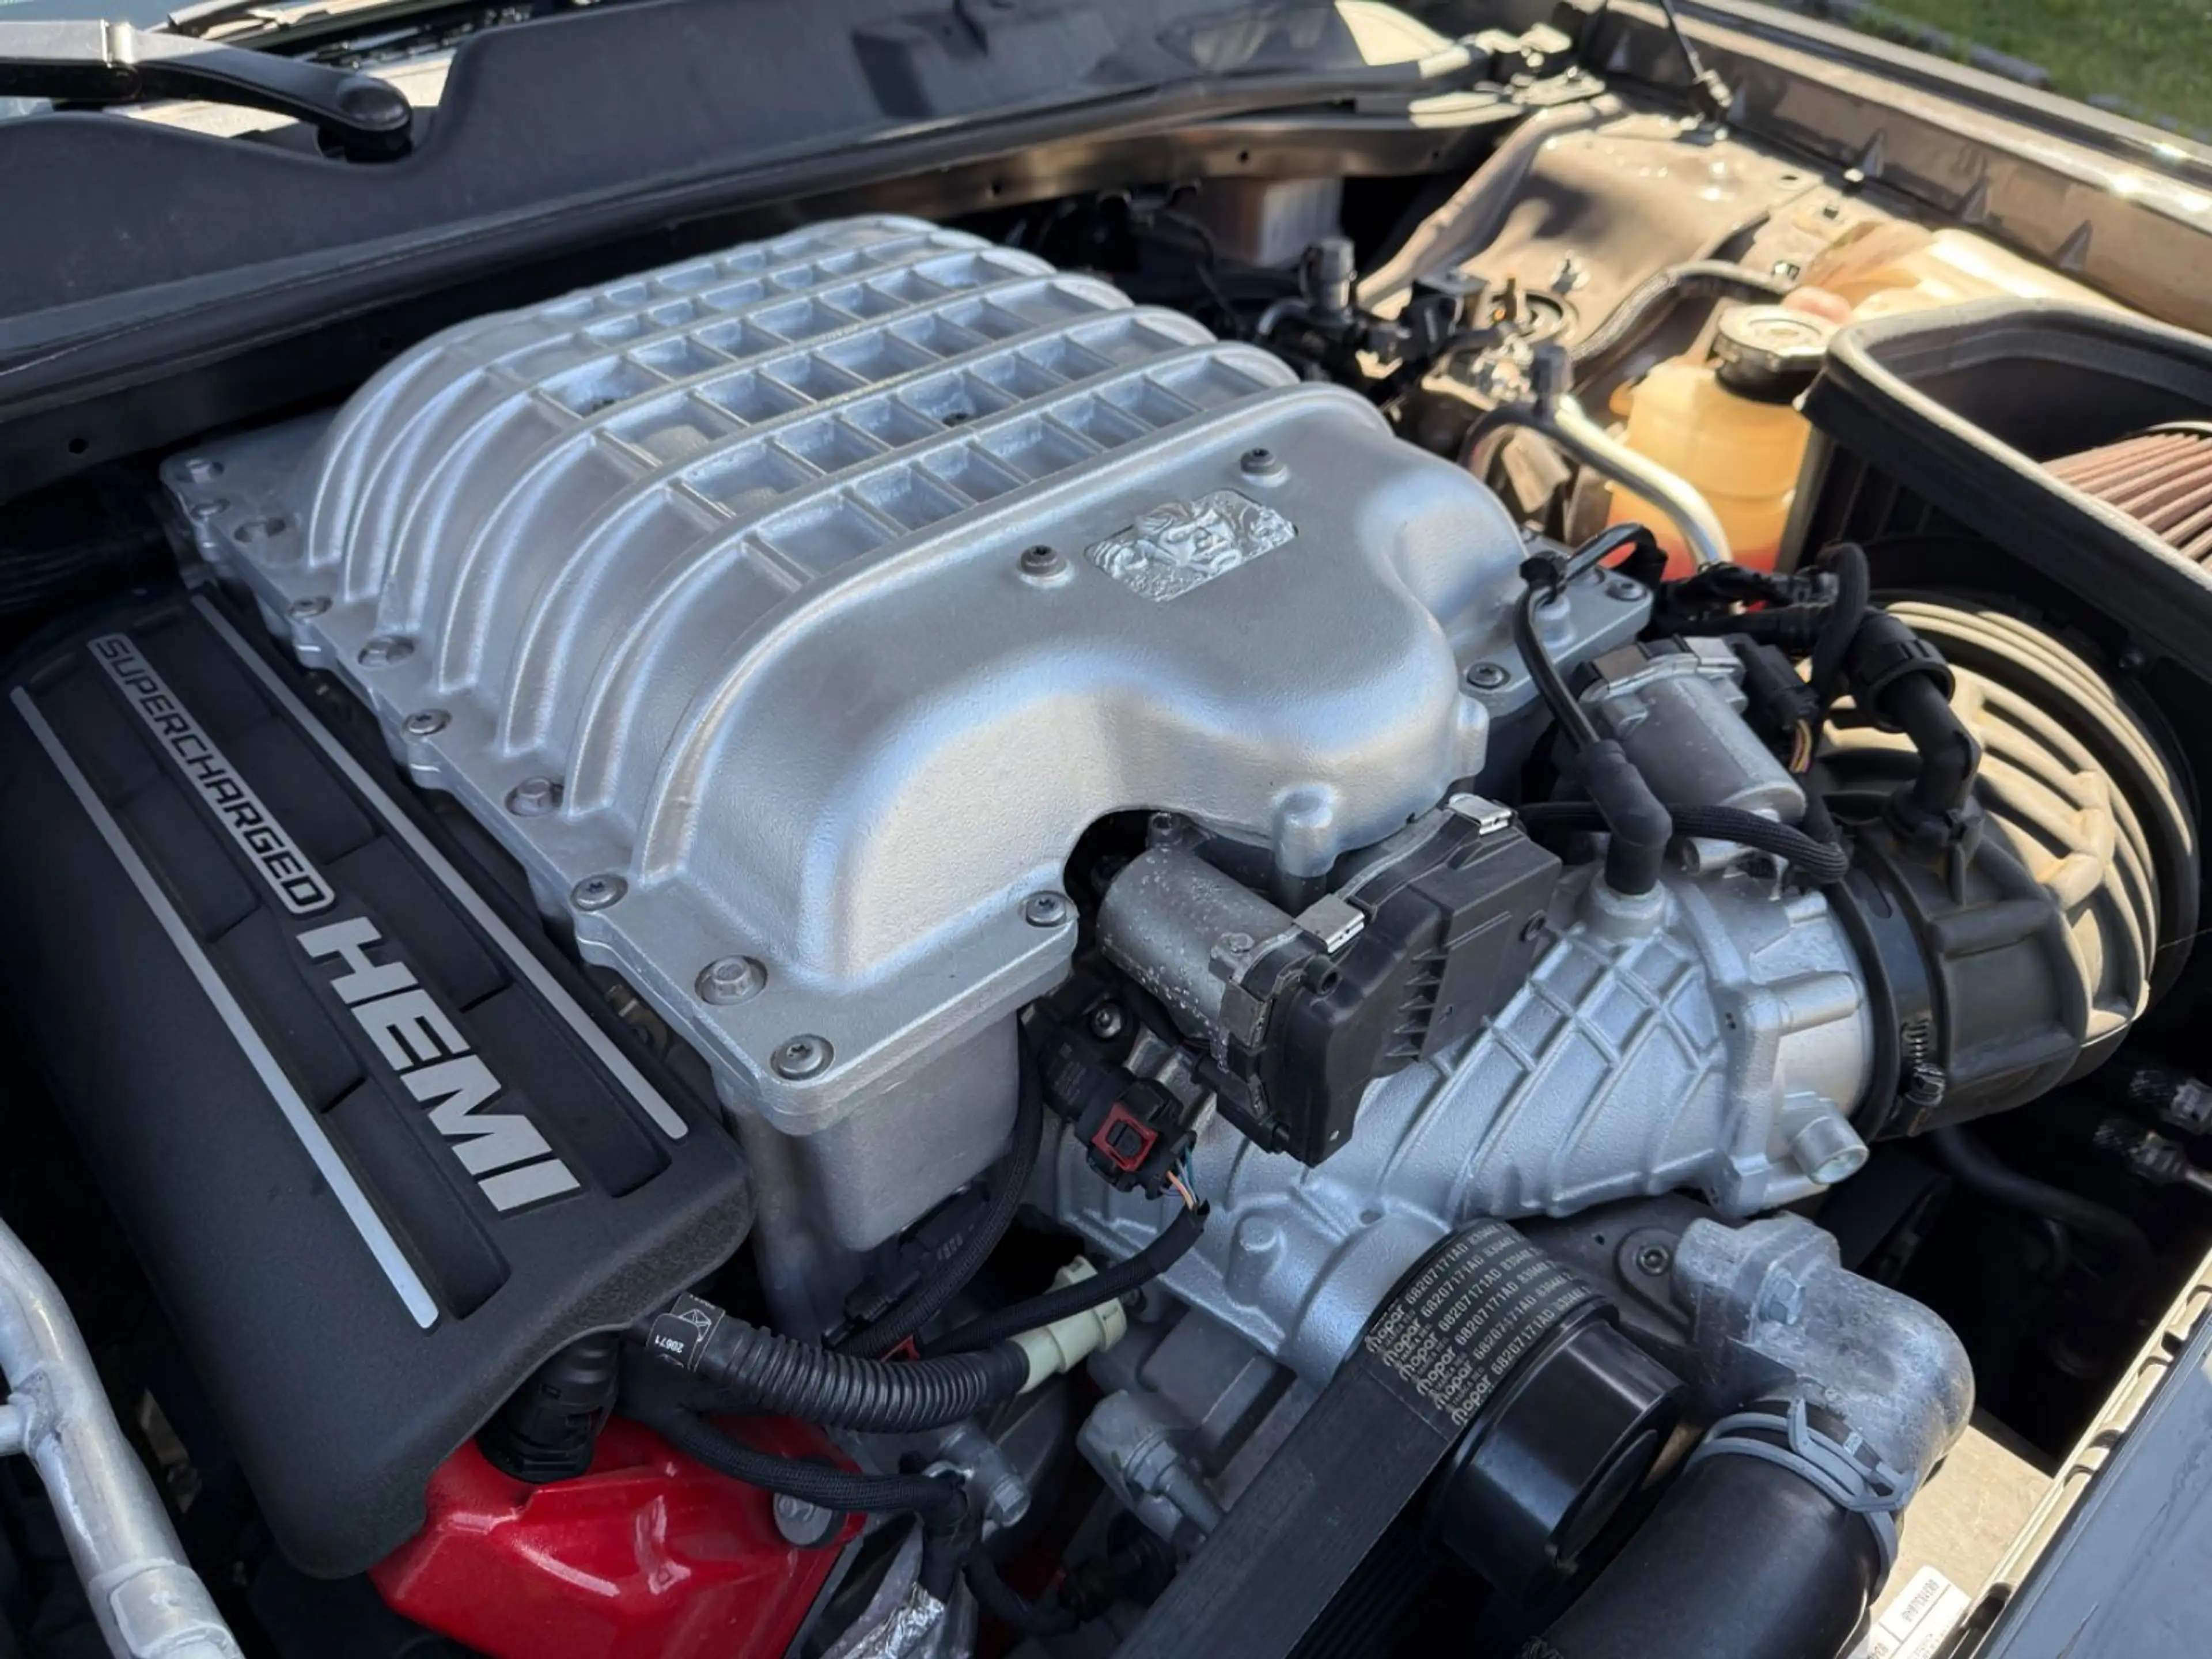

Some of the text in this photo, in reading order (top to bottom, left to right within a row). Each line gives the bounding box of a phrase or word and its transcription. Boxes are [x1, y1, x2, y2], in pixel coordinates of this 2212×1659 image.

[94, 638, 326, 910] SUPERCHARGED
[297, 916, 581, 1211] HEMI
[1406, 1243, 1469, 1305] 68207171AD
[1421, 1254, 1484, 1317] 68207171AD
[1438, 1268, 1502, 1332] 68207171AD
[1455, 1282, 1518, 1346] 68207171AD
[1491, 1309, 1555, 1375] 68207171AD
